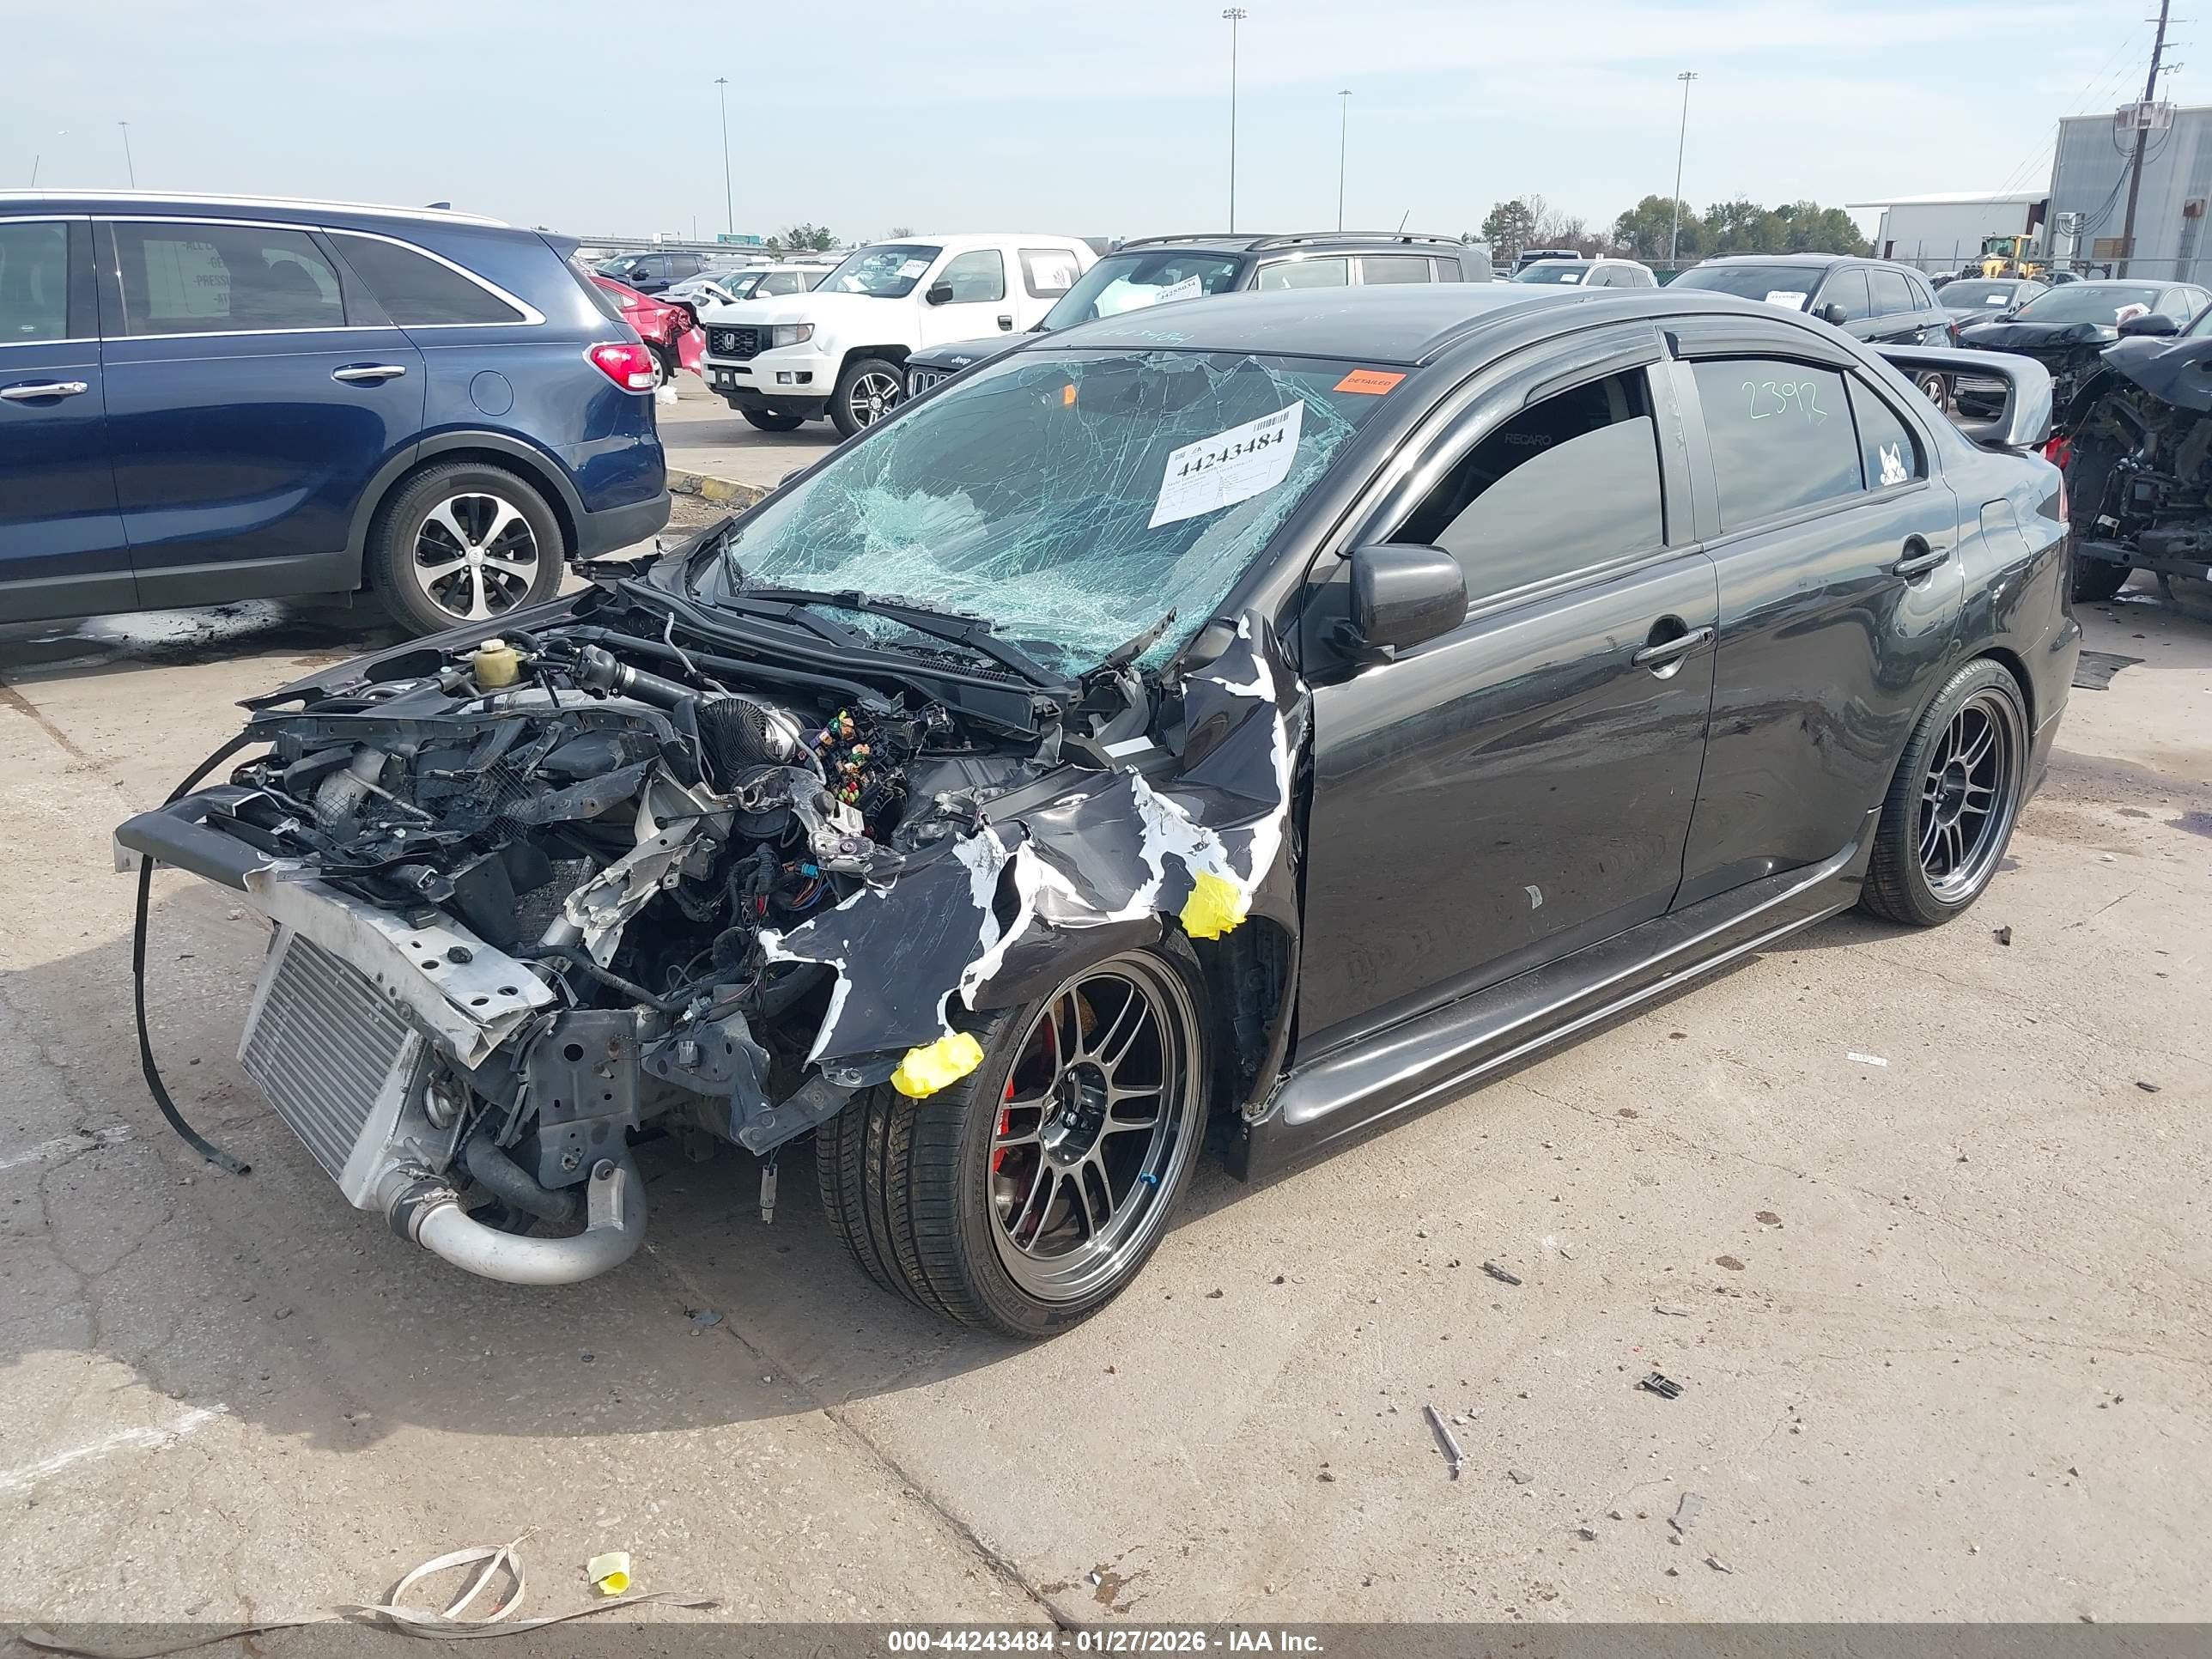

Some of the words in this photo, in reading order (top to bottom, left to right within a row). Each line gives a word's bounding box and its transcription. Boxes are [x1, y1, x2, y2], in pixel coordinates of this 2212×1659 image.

[951, 356, 972, 366] Jeep
[1347, 378, 1392, 386] DETAILED
[1741, 380, 1828, 419] 2392
[1504, 433, 1553, 446] RECARO
[1177, 428, 1285, 477] 44243484
